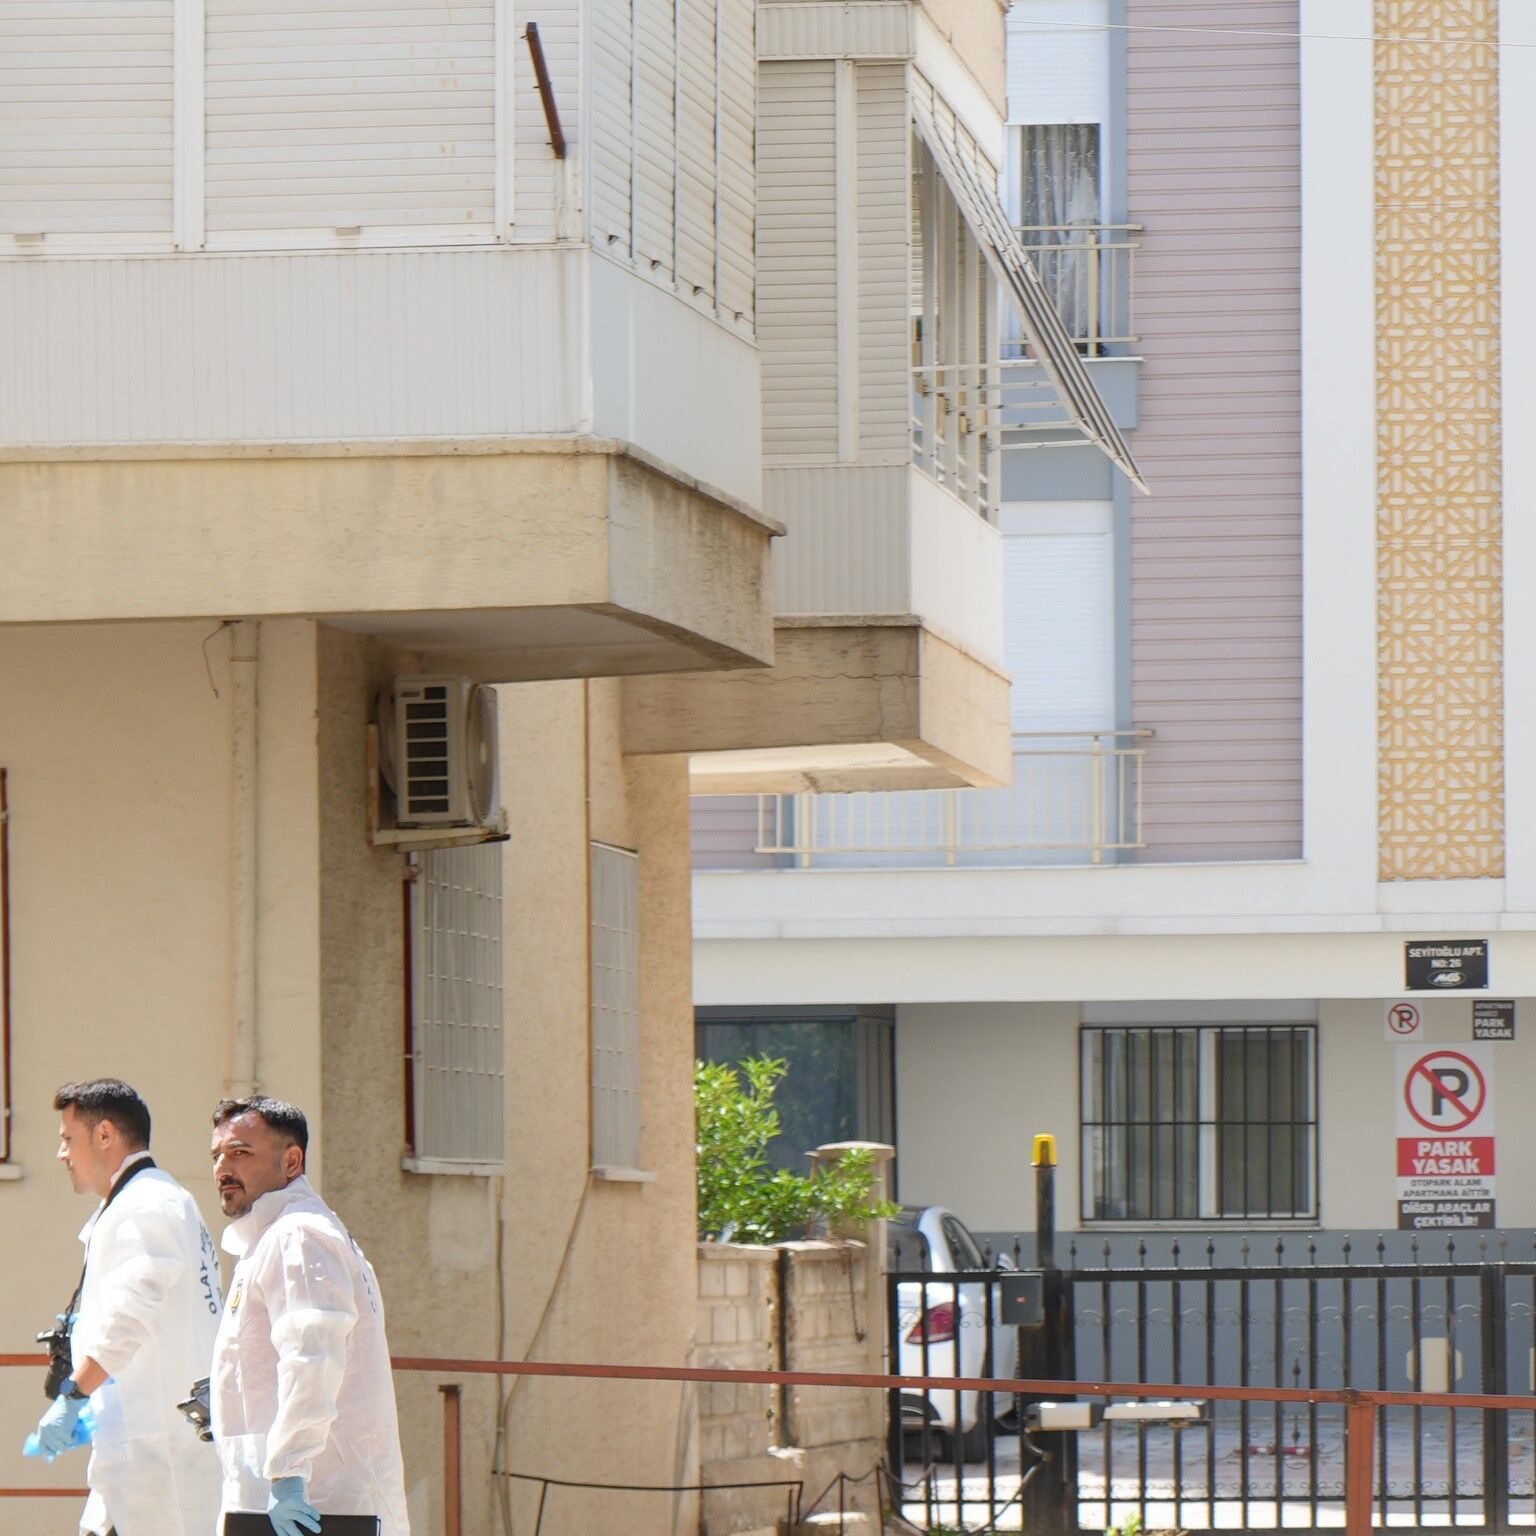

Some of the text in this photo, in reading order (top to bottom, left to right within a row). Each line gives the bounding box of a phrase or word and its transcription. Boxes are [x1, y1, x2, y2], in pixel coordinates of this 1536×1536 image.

[1462, 946, 1484, 957] APT.
[1474, 1018, 1505, 1028] PARK
[1474, 1028, 1513, 1038] YASAK
[1417, 1141, 1472, 1156] PARK
[1412, 1158, 1480, 1174] YASAK
[1410, 1179, 1452, 1187] OTOPARK
[1436, 1202, 1491, 1215] ARAÇLAR
